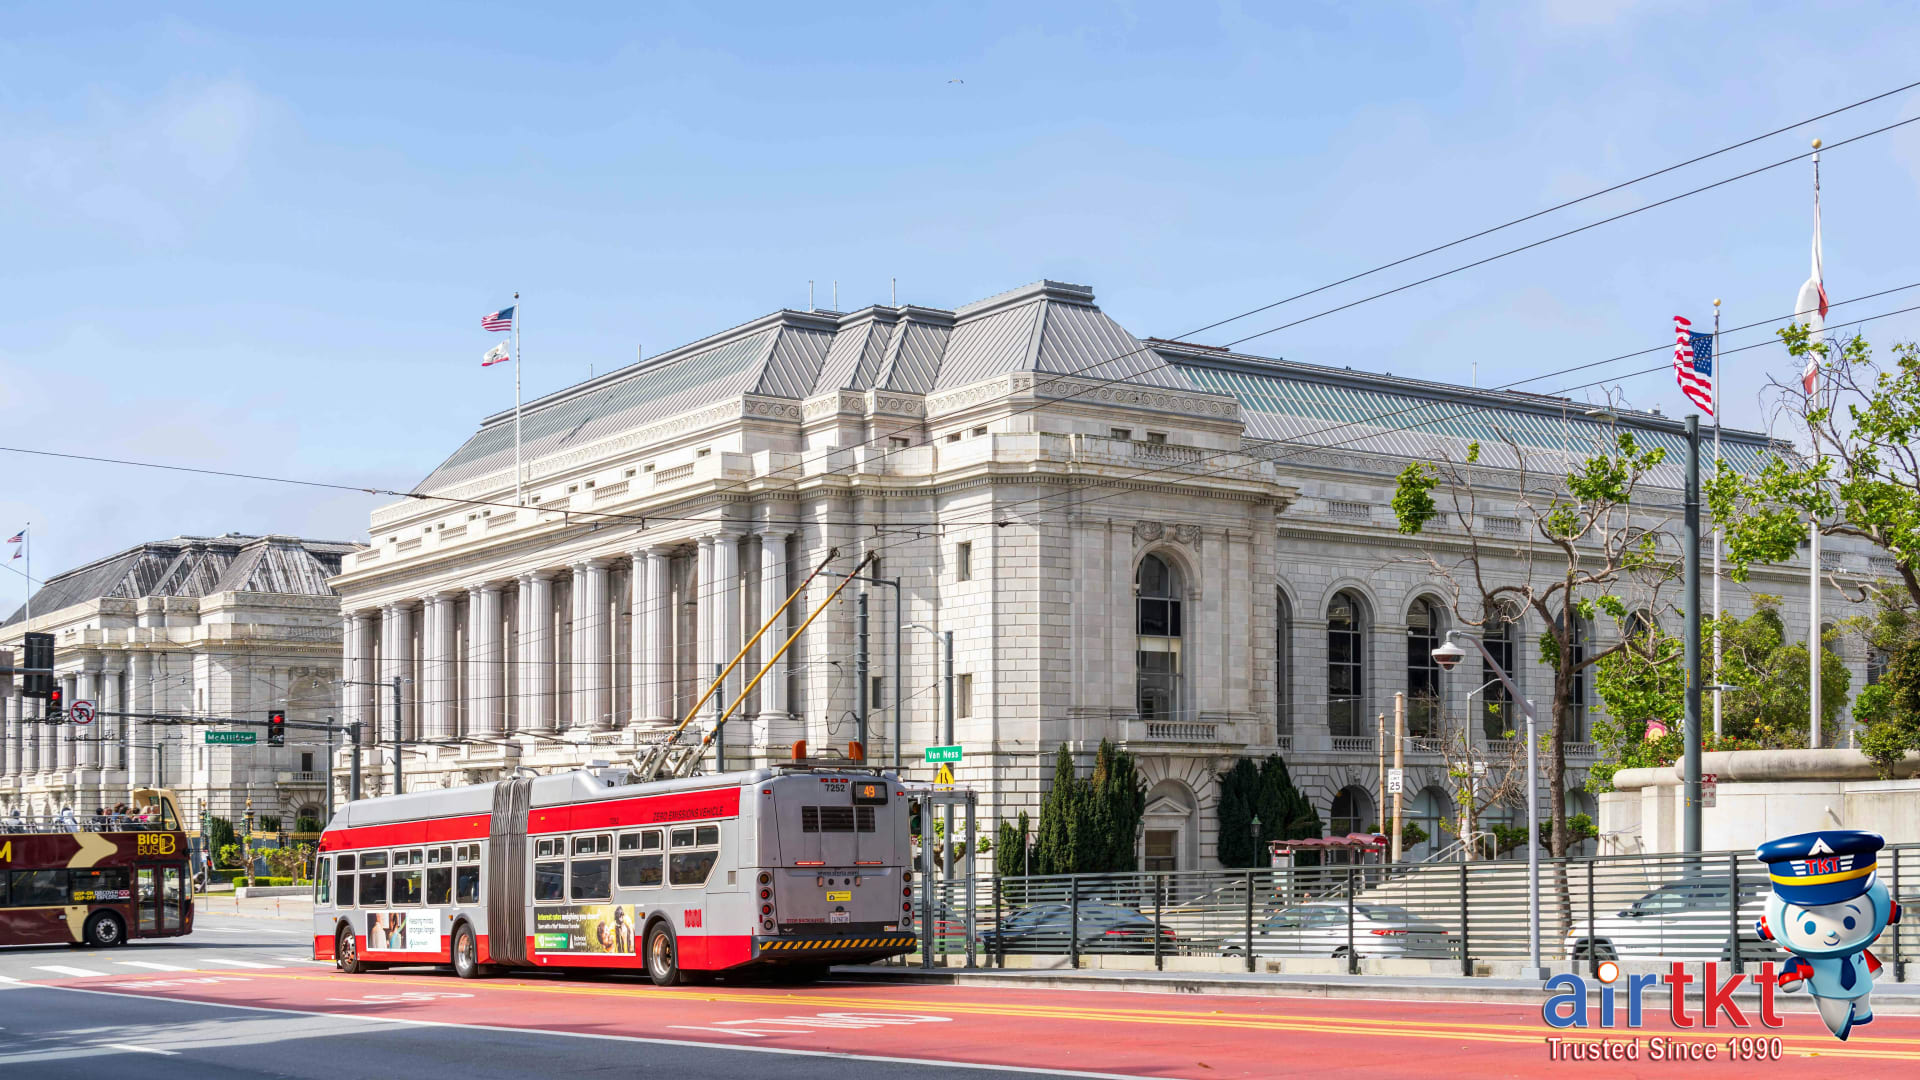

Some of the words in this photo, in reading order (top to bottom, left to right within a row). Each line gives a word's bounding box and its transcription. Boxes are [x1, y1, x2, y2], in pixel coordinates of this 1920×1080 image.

[928, 751, 940, 760] Van
[943, 750, 959, 759] Ness
[825, 784, 846, 792] 7252
[1390, 782, 1400, 790] 25
[864, 785, 875, 798] 49
[668, 809, 698, 820] EMISSIONS
[699, 806, 724, 817] VEHICLE
[138, 834, 159, 845] BIG
[138, 845, 160, 855] BUS
